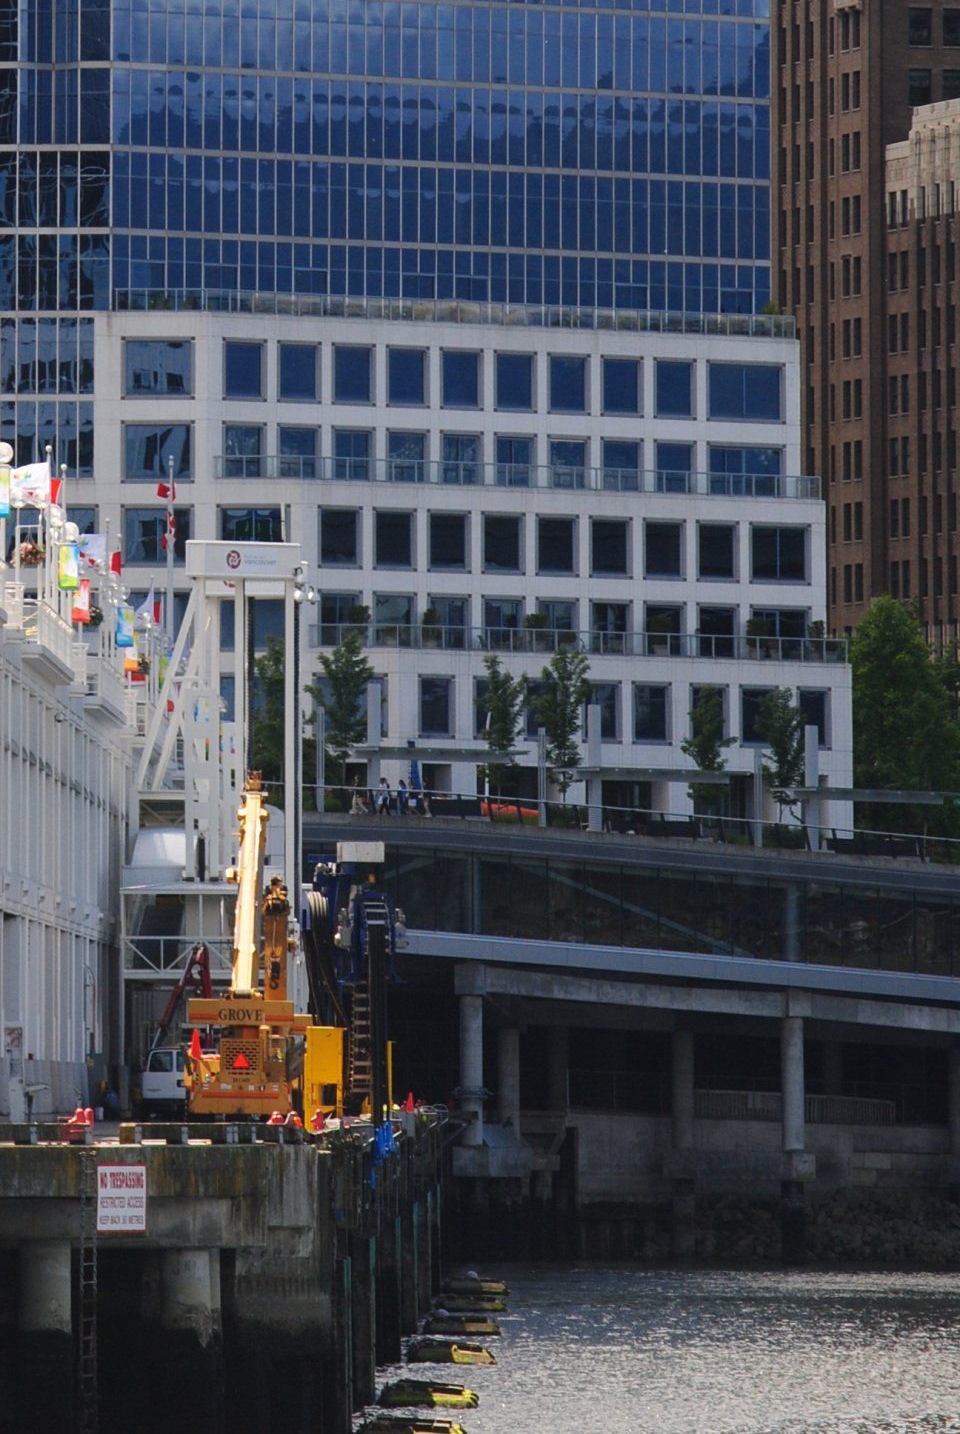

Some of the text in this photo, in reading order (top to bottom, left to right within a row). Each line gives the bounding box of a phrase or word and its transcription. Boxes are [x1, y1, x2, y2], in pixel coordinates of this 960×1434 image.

[217, 1008, 264, 1022] GROVE
[100, 1172, 144, 1189] NO TRESPASSING
